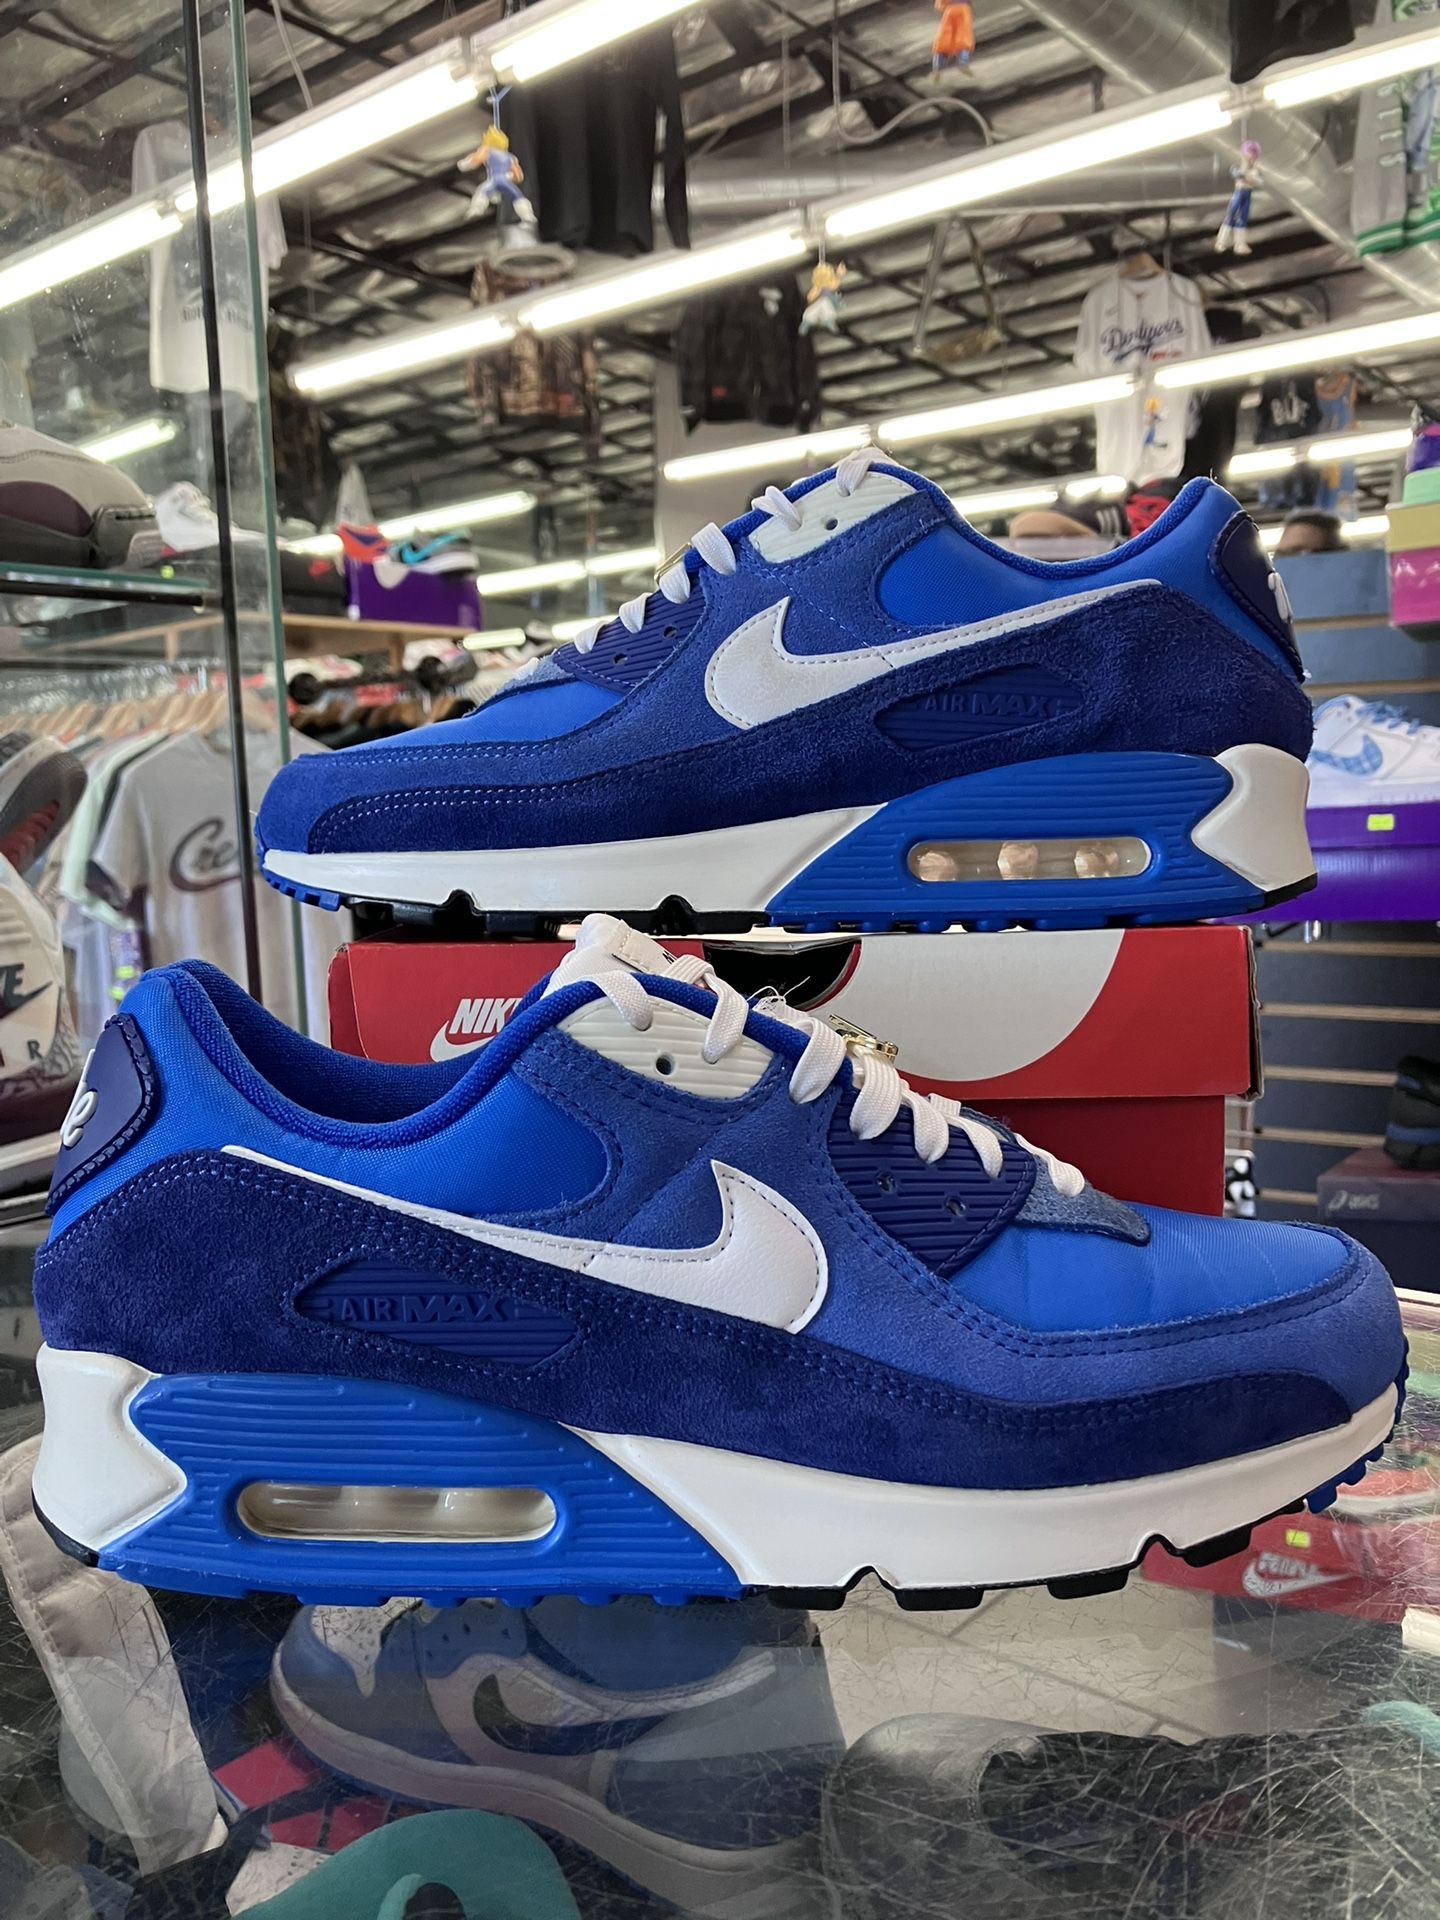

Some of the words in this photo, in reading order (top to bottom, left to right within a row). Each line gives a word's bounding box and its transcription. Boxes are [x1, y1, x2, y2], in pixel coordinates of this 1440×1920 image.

[924, 693, 963, 713] AIR
[971, 693, 1047, 716] MAX
[341, 1297, 392, 1321] AIR
[402, 1295, 508, 1322] MAX
